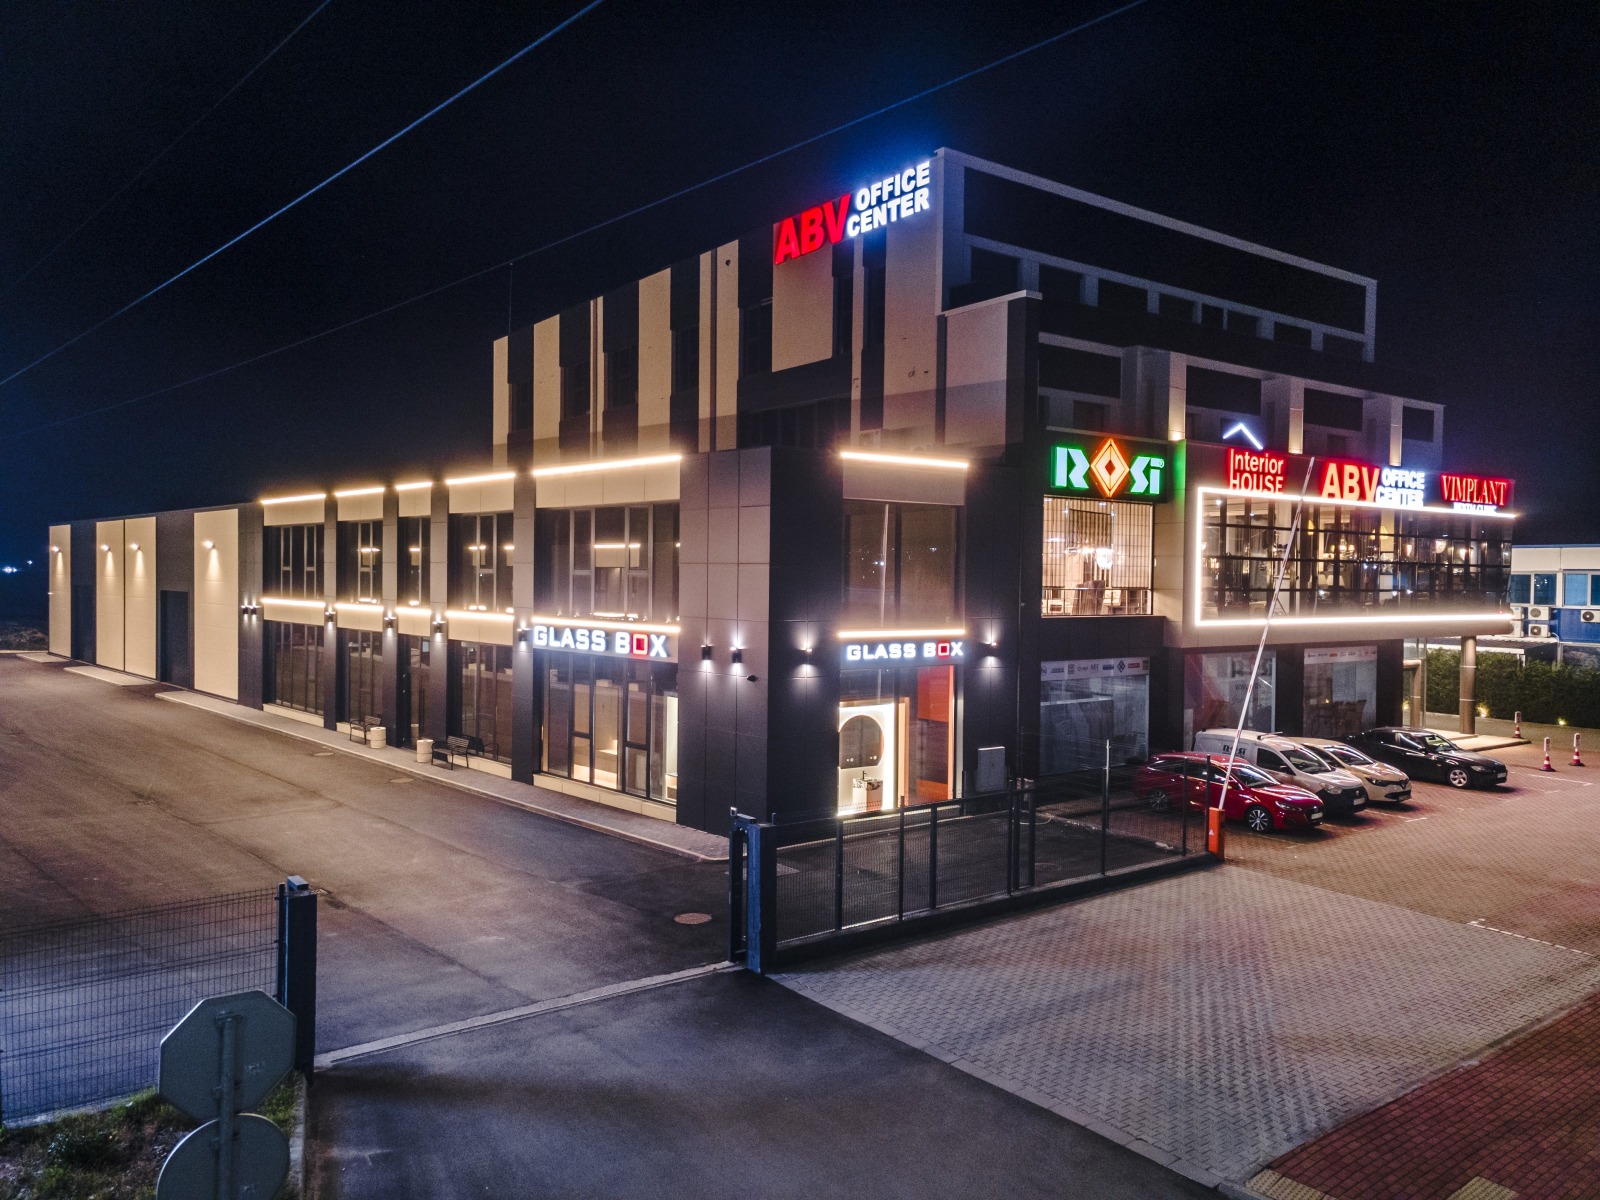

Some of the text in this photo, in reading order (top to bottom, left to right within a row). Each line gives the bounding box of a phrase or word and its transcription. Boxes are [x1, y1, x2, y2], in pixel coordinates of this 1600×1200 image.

[855, 161, 930, 211] OFFICE
[847, 188, 930, 237] CENTER
[774, 193, 851, 265] ABV
[1229, 448, 1284, 475] Interior
[1229, 472, 1284, 494] HOUSE
[1321, 462, 1381, 503] ABV
[1381, 468, 1425, 489] OFFICE
[1441, 475, 1507, 506] VIMPLANT
[1375, 486, 1423, 507] CENTER
[533, 625, 667, 658] GLASS BOX
[846, 641, 963, 661] GLASS BOX
